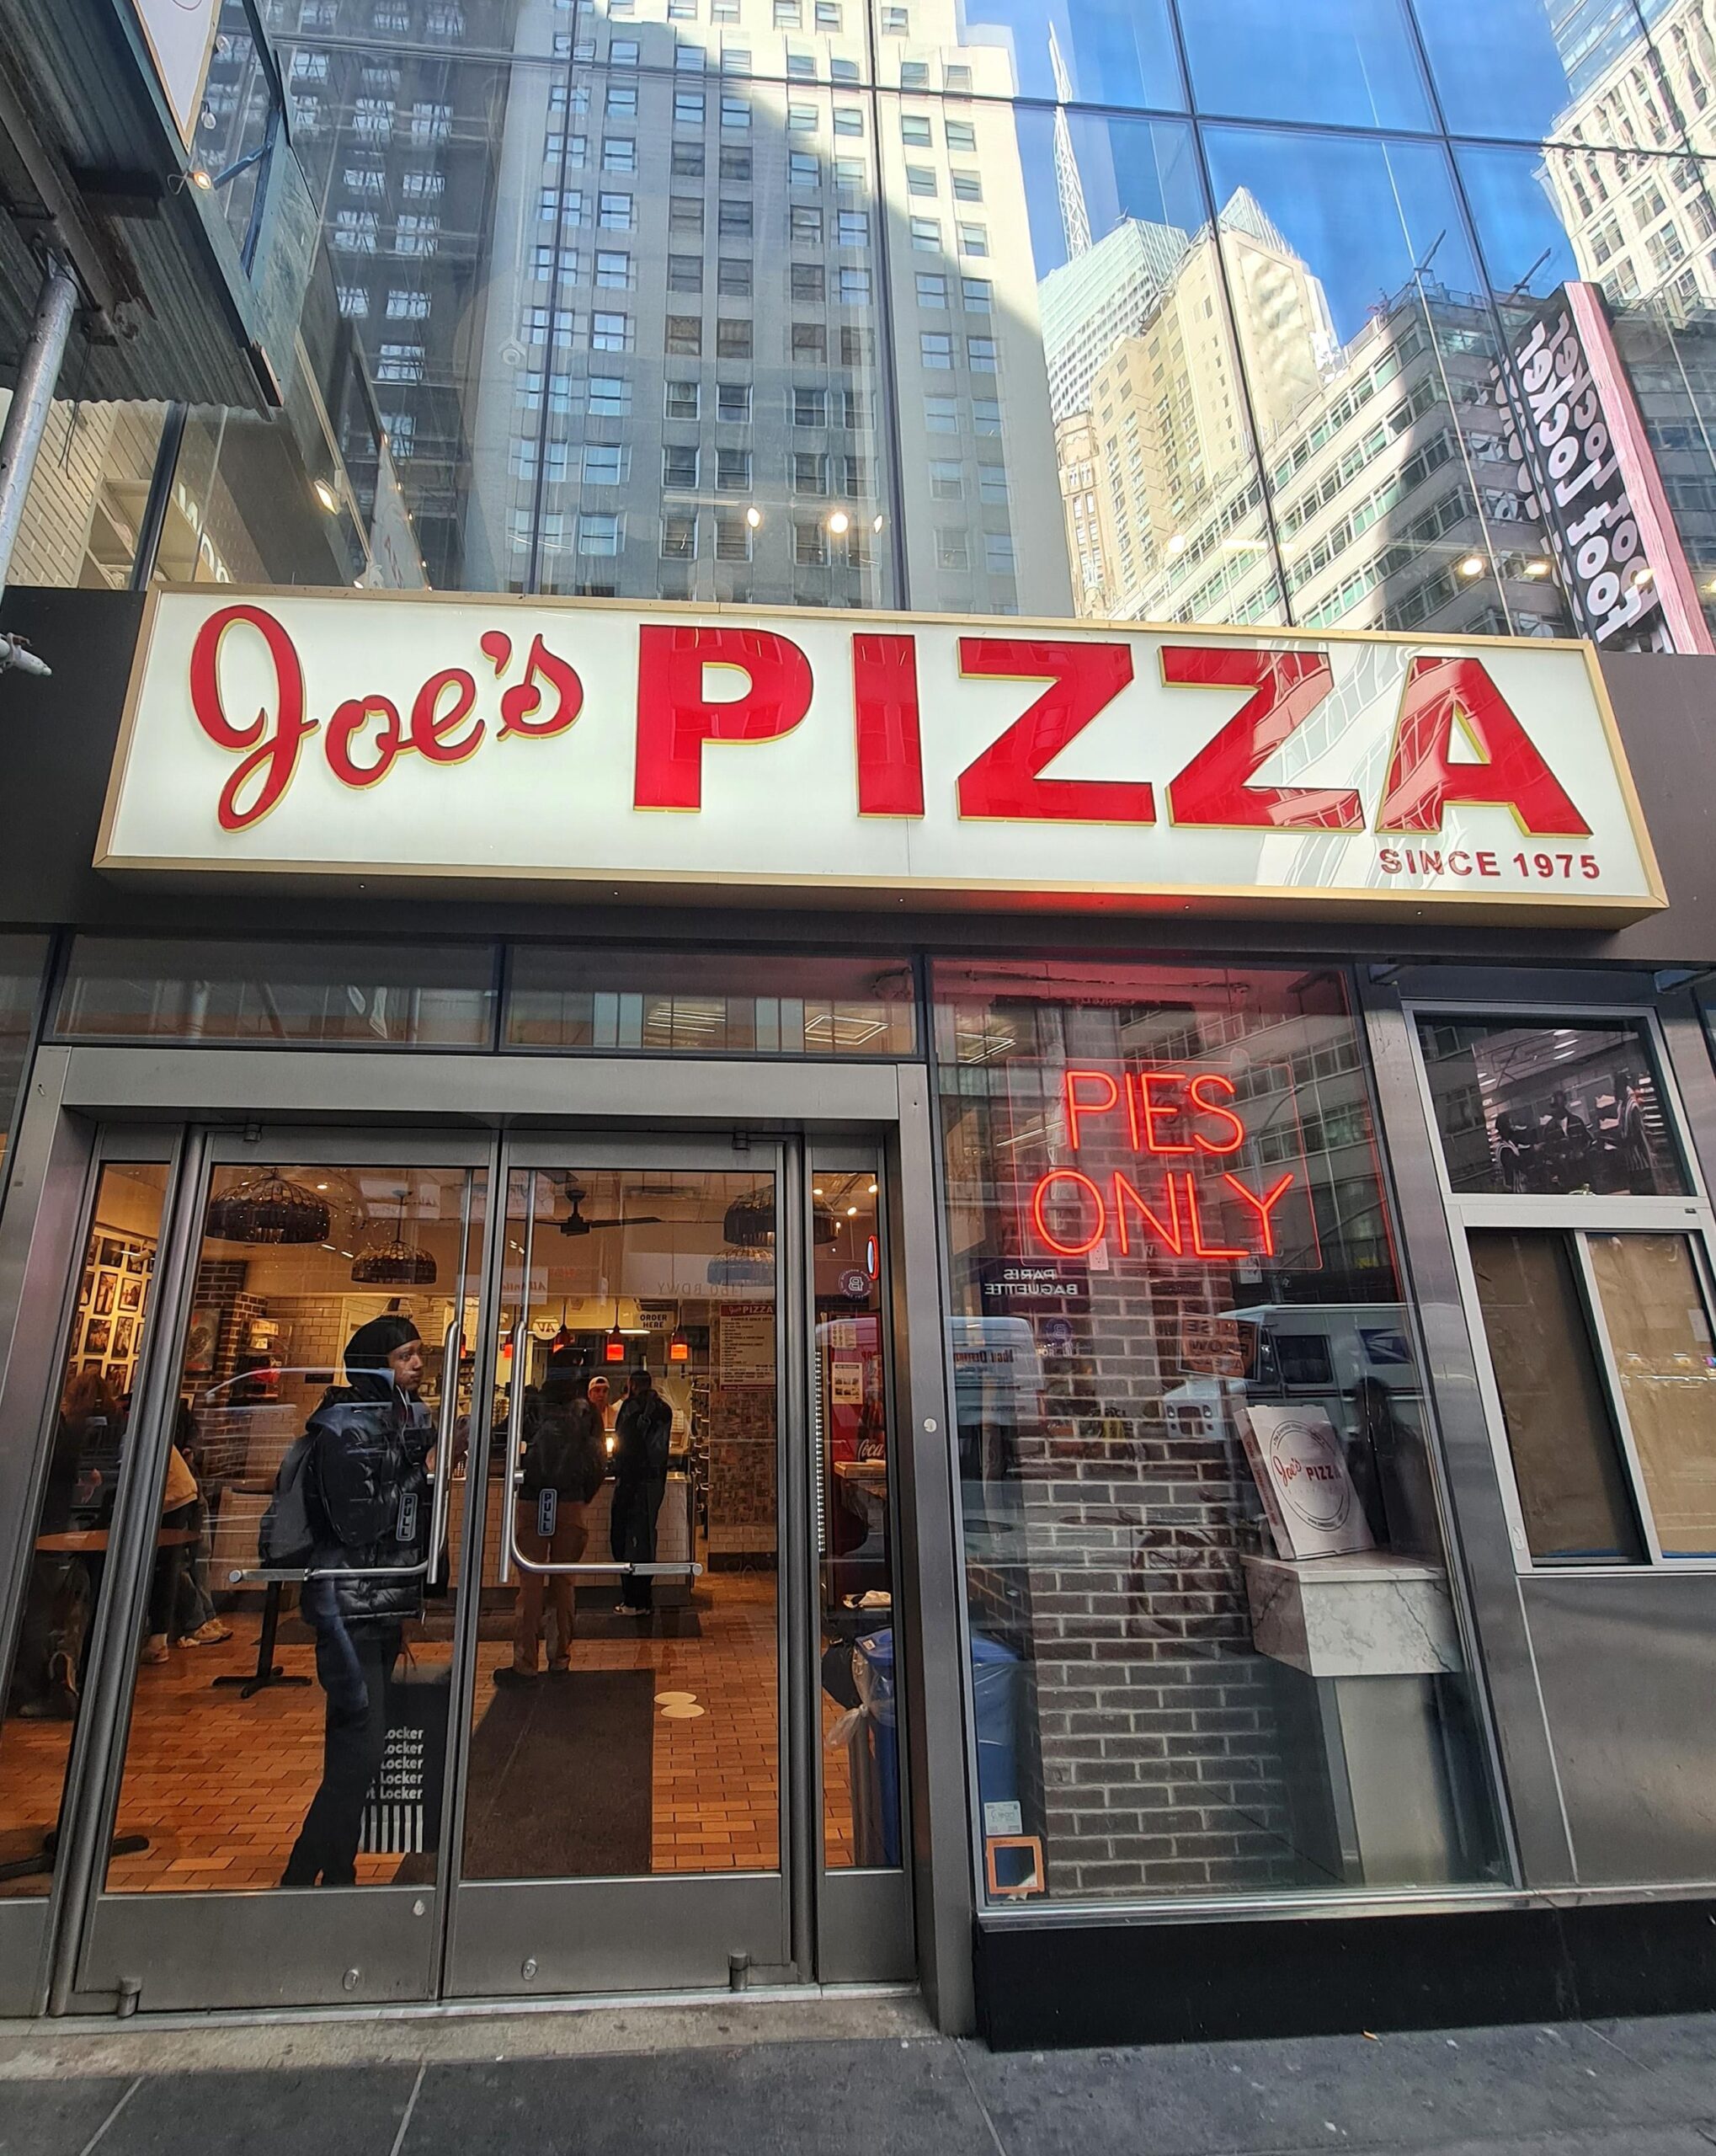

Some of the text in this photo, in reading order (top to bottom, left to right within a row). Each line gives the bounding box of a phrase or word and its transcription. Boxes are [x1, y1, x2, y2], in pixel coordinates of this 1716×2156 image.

[189, 603, 1594, 839] Joe's PIZZA
[1378, 848, 1601, 879] SINCE 1975
[1065, 1070, 1245, 1154] PIES
[1033, 1167, 1295, 1257] ONLY
[743, 1305, 774, 1314] PIZZA
[1272, 1455, 1302, 1487] Joe's
[400, 1497, 413, 1537] PULL
[542, 1492, 552, 1532] PULL
[384, 1726, 424, 1740] ocker
[384, 1740, 424, 1754] ocker
[380, 1770, 424, 1785] Locker
[380, 1785, 423, 1800] Locker
